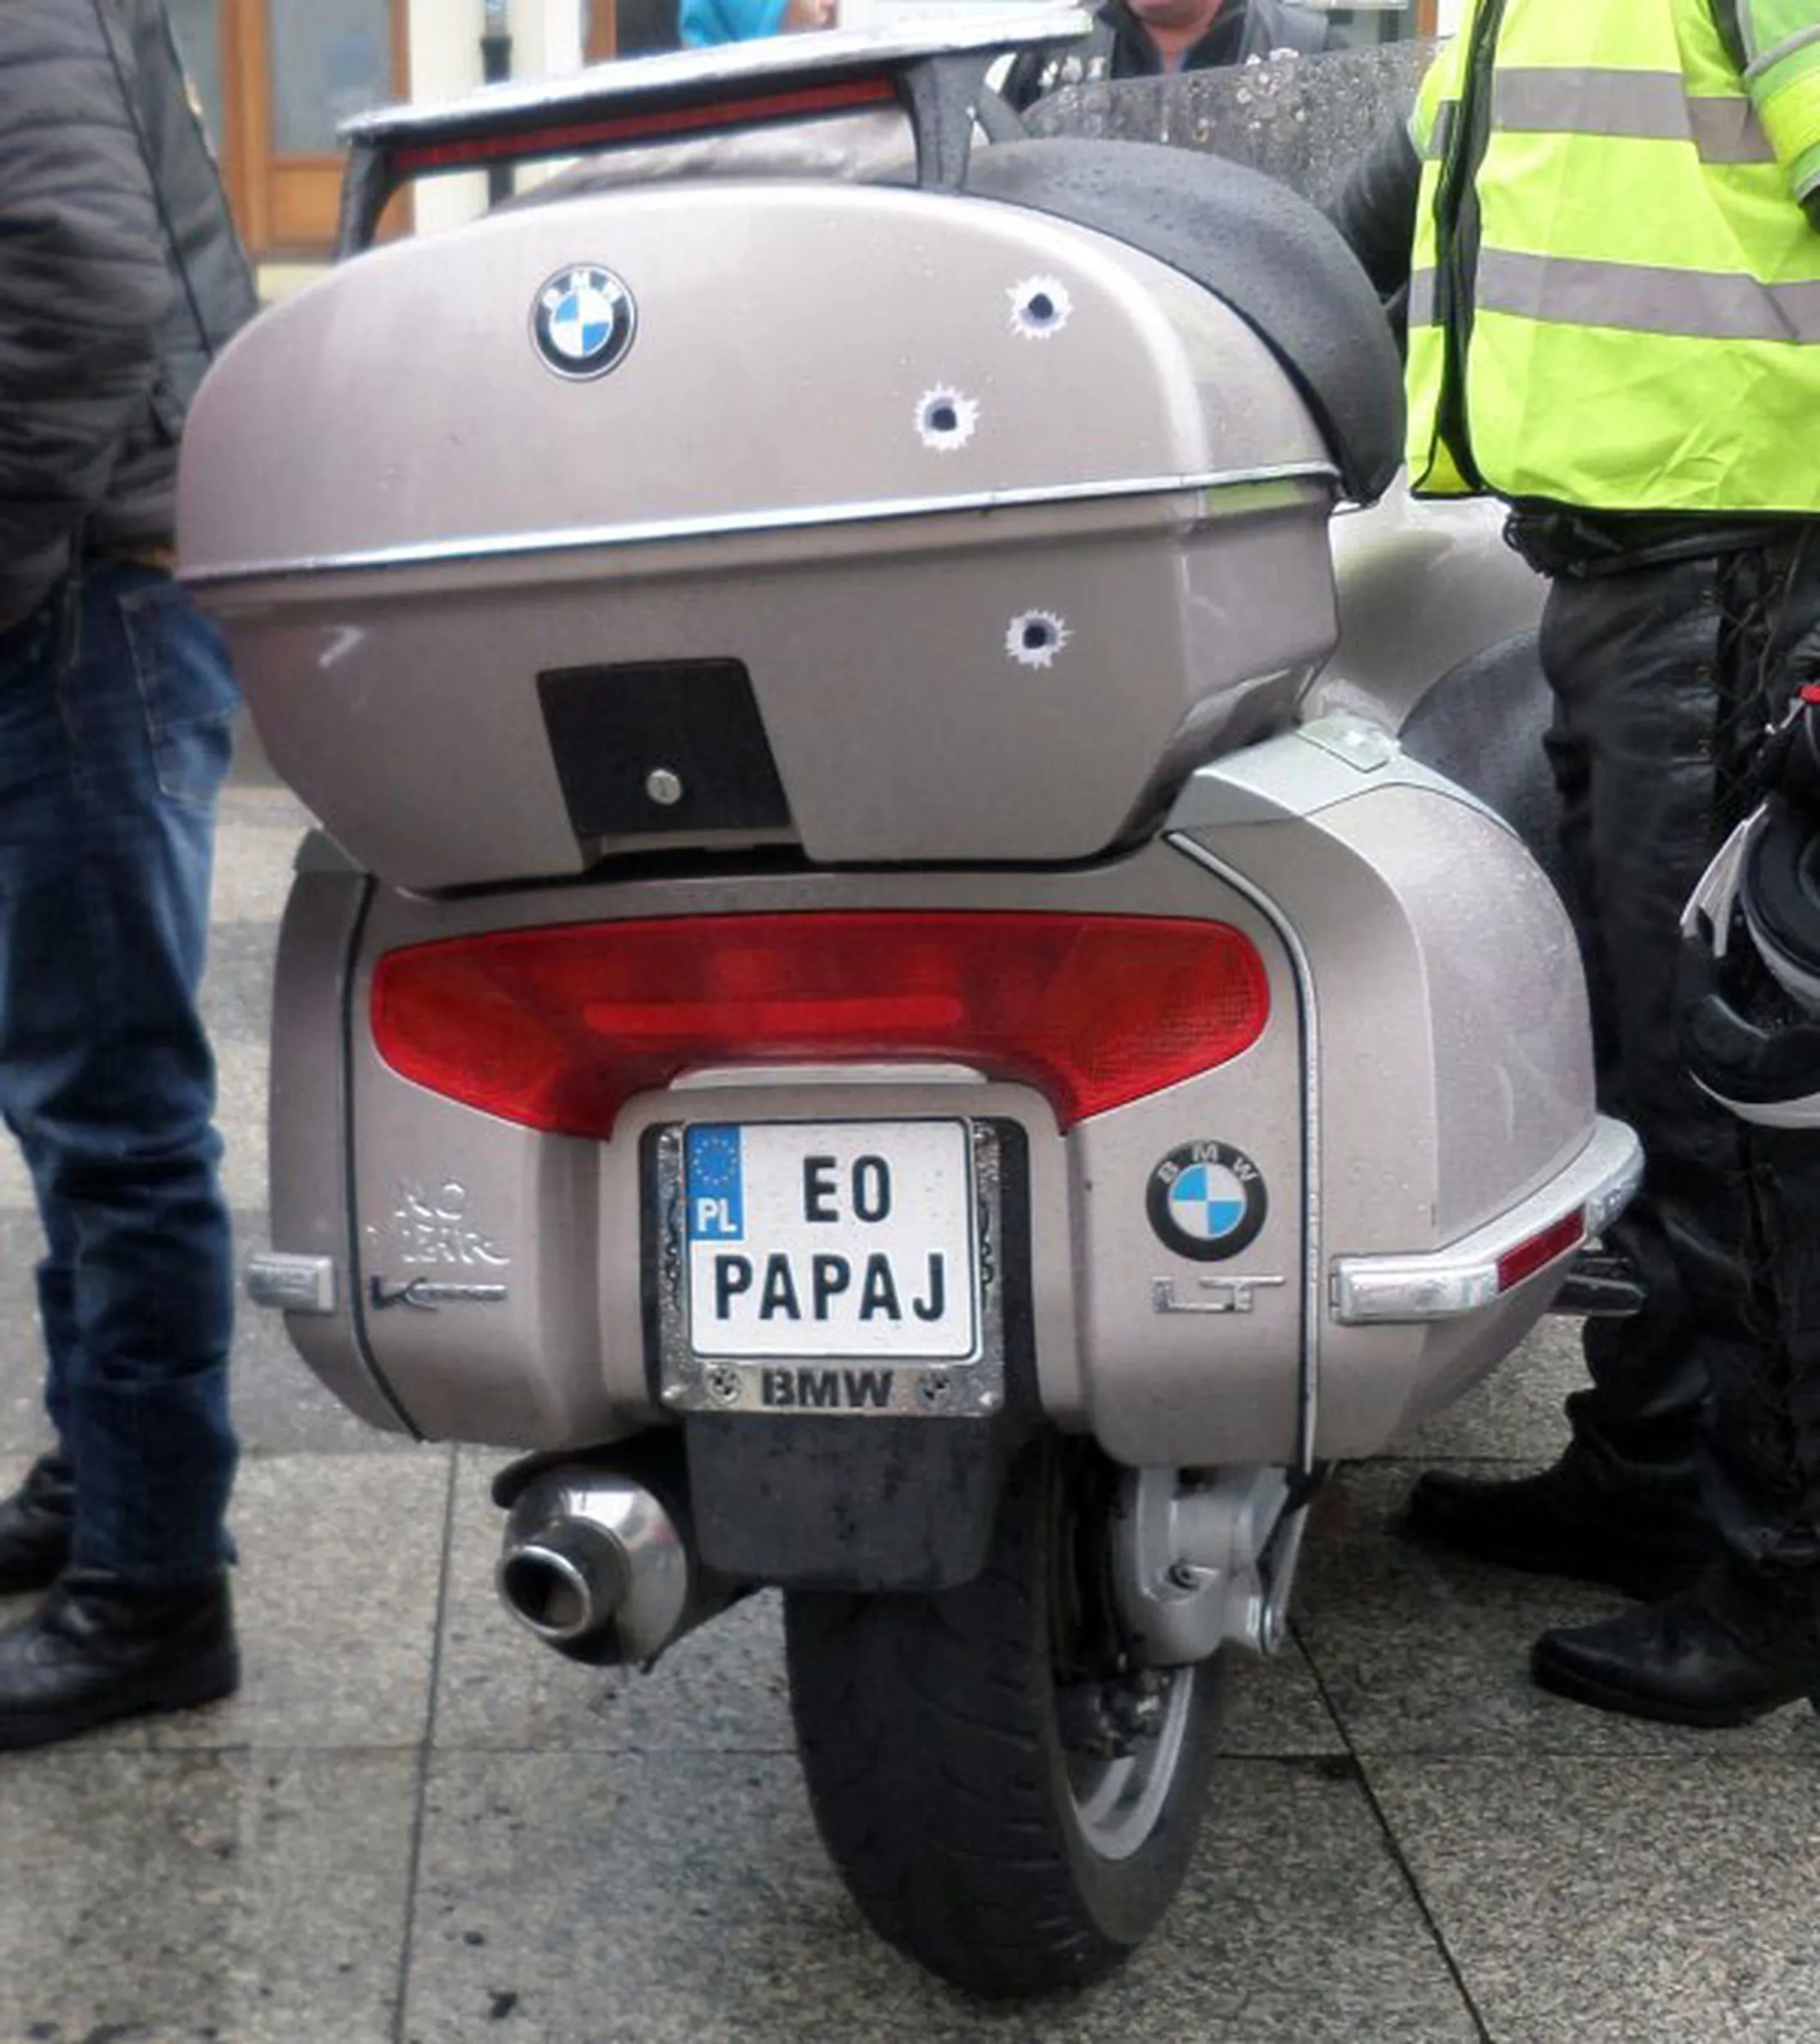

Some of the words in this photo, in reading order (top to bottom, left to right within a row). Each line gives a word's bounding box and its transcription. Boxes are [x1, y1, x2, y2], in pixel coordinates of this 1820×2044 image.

[542, 270, 623, 309] BMW
[1158, 1145, 1259, 1183] BMW
[695, 1197, 737, 1233] PL
[715, 1253, 945, 1321] PAPAJ
[762, 1369, 894, 1408] BMW
